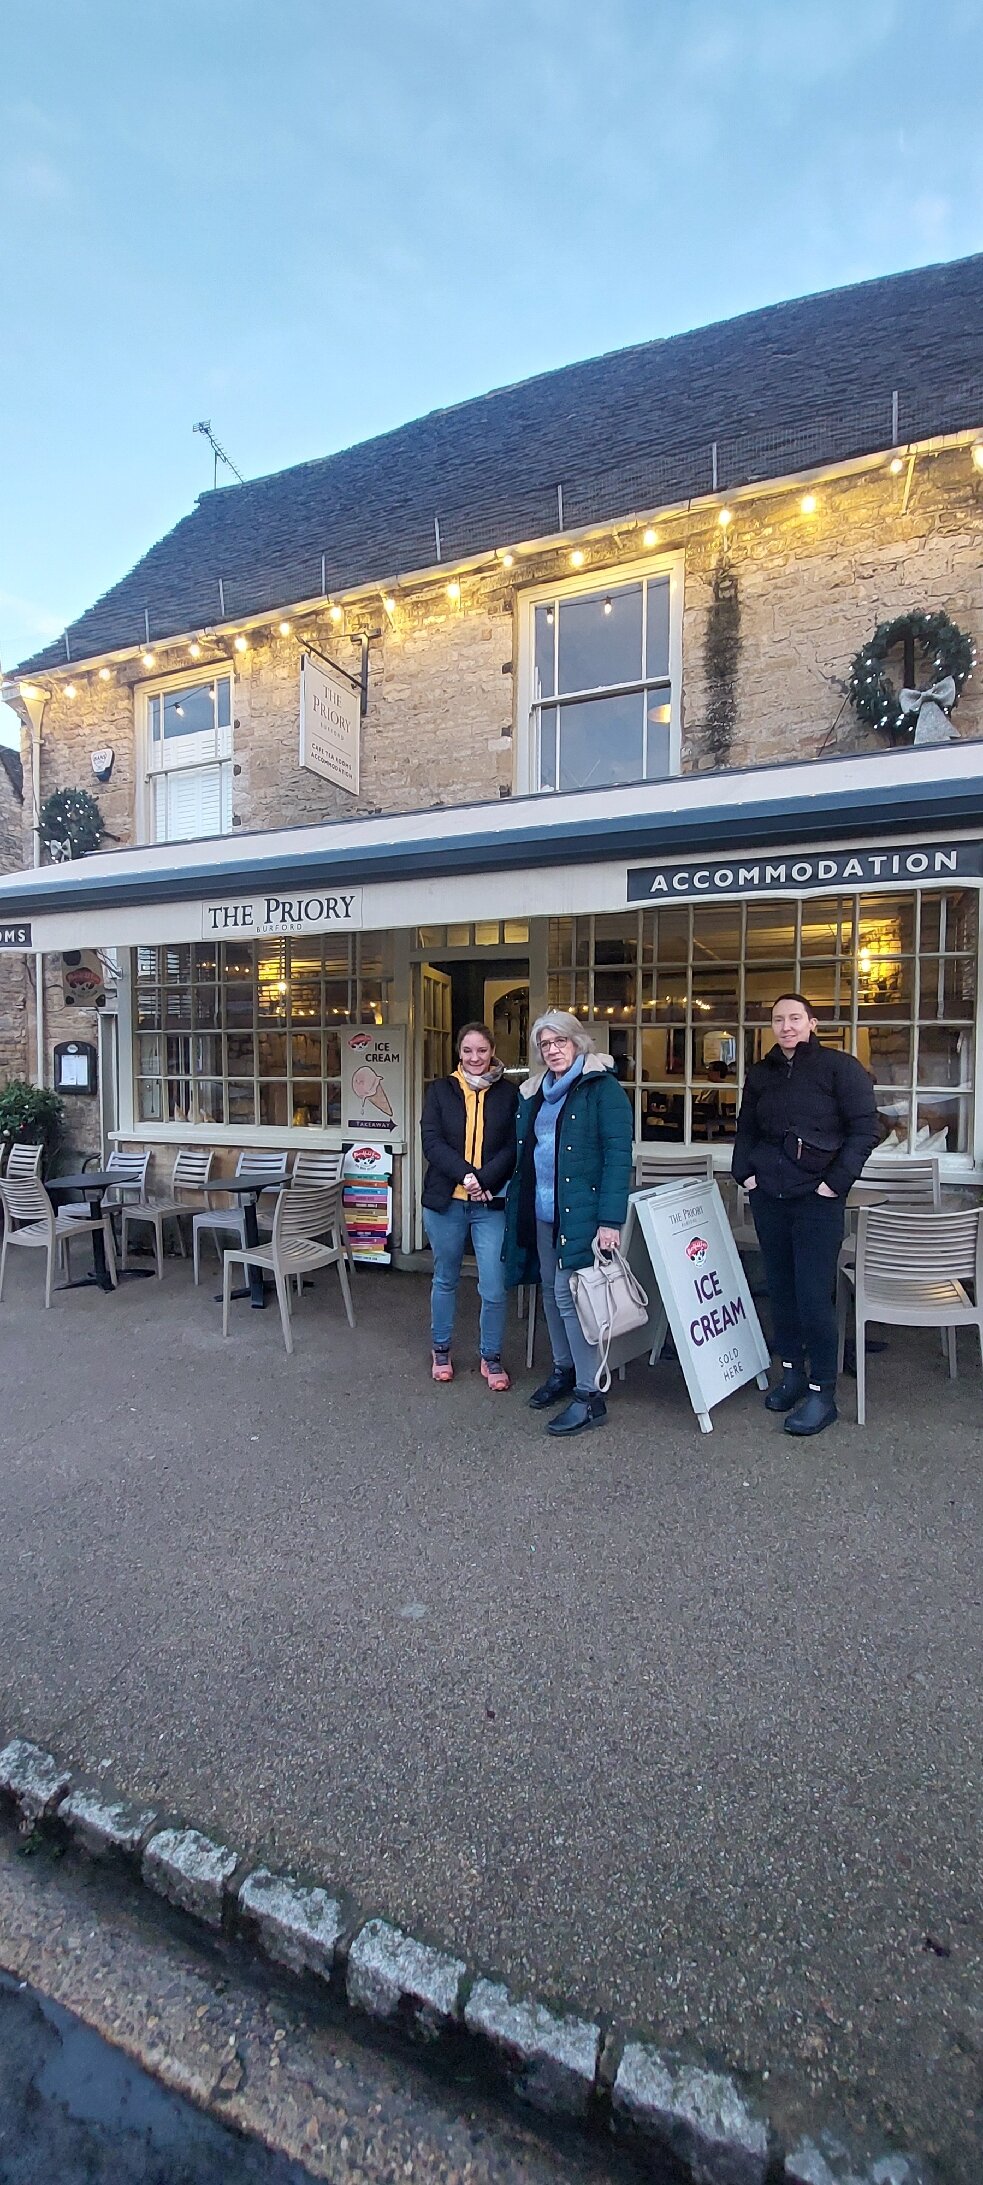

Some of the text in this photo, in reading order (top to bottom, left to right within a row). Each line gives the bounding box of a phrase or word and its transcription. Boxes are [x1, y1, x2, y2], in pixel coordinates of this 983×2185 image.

[322, 684, 342, 708] THE
[312, 694, 351, 733] PRIORY
[650, 850, 958, 893] ACCOMMODATION
[208, 895, 355, 929] THE PRIORY
[0, 929, 26, 943] MS
[256, 923, 302, 933] BURFORD
[374, 1042, 390, 1051] ICE
[365, 1053, 400, 1062] CREAM
[356, 1121, 391, 1129] TAKEAWAY
[694, 1270, 723, 1304] ICE
[690, 1296, 746, 1346] CREAM
[718, 1347, 739, 1368] SOLD
[723, 1361, 744, 1382] HERE
